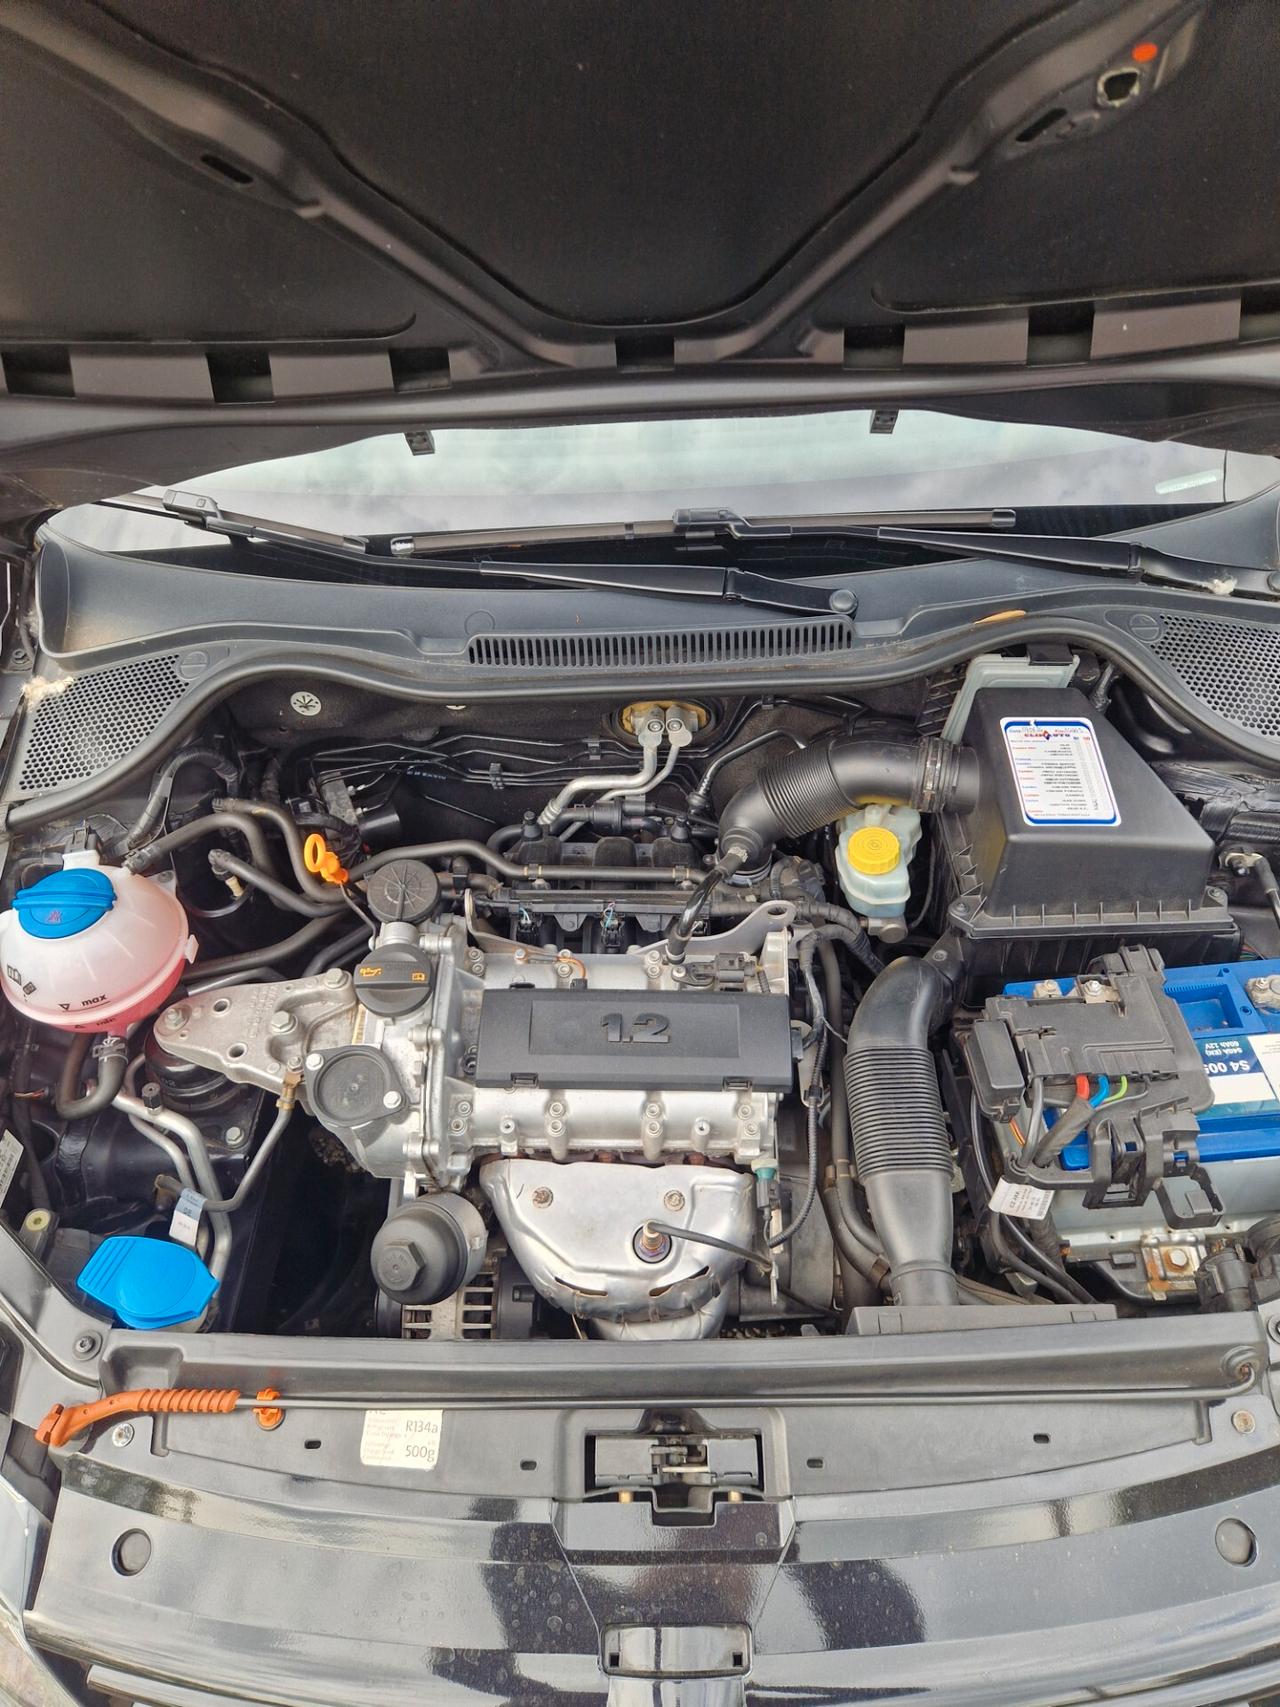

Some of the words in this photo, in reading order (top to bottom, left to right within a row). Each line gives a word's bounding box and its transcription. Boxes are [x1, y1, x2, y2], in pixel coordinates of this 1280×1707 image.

[81, 994, 107, 1007] max
[602, 1013, 670, 1043] 1.2
[1229, 1060, 1250, 1072] S4
[406, 1420, 438, 1433] R134a
[405, 1445, 435, 1462] 500g
